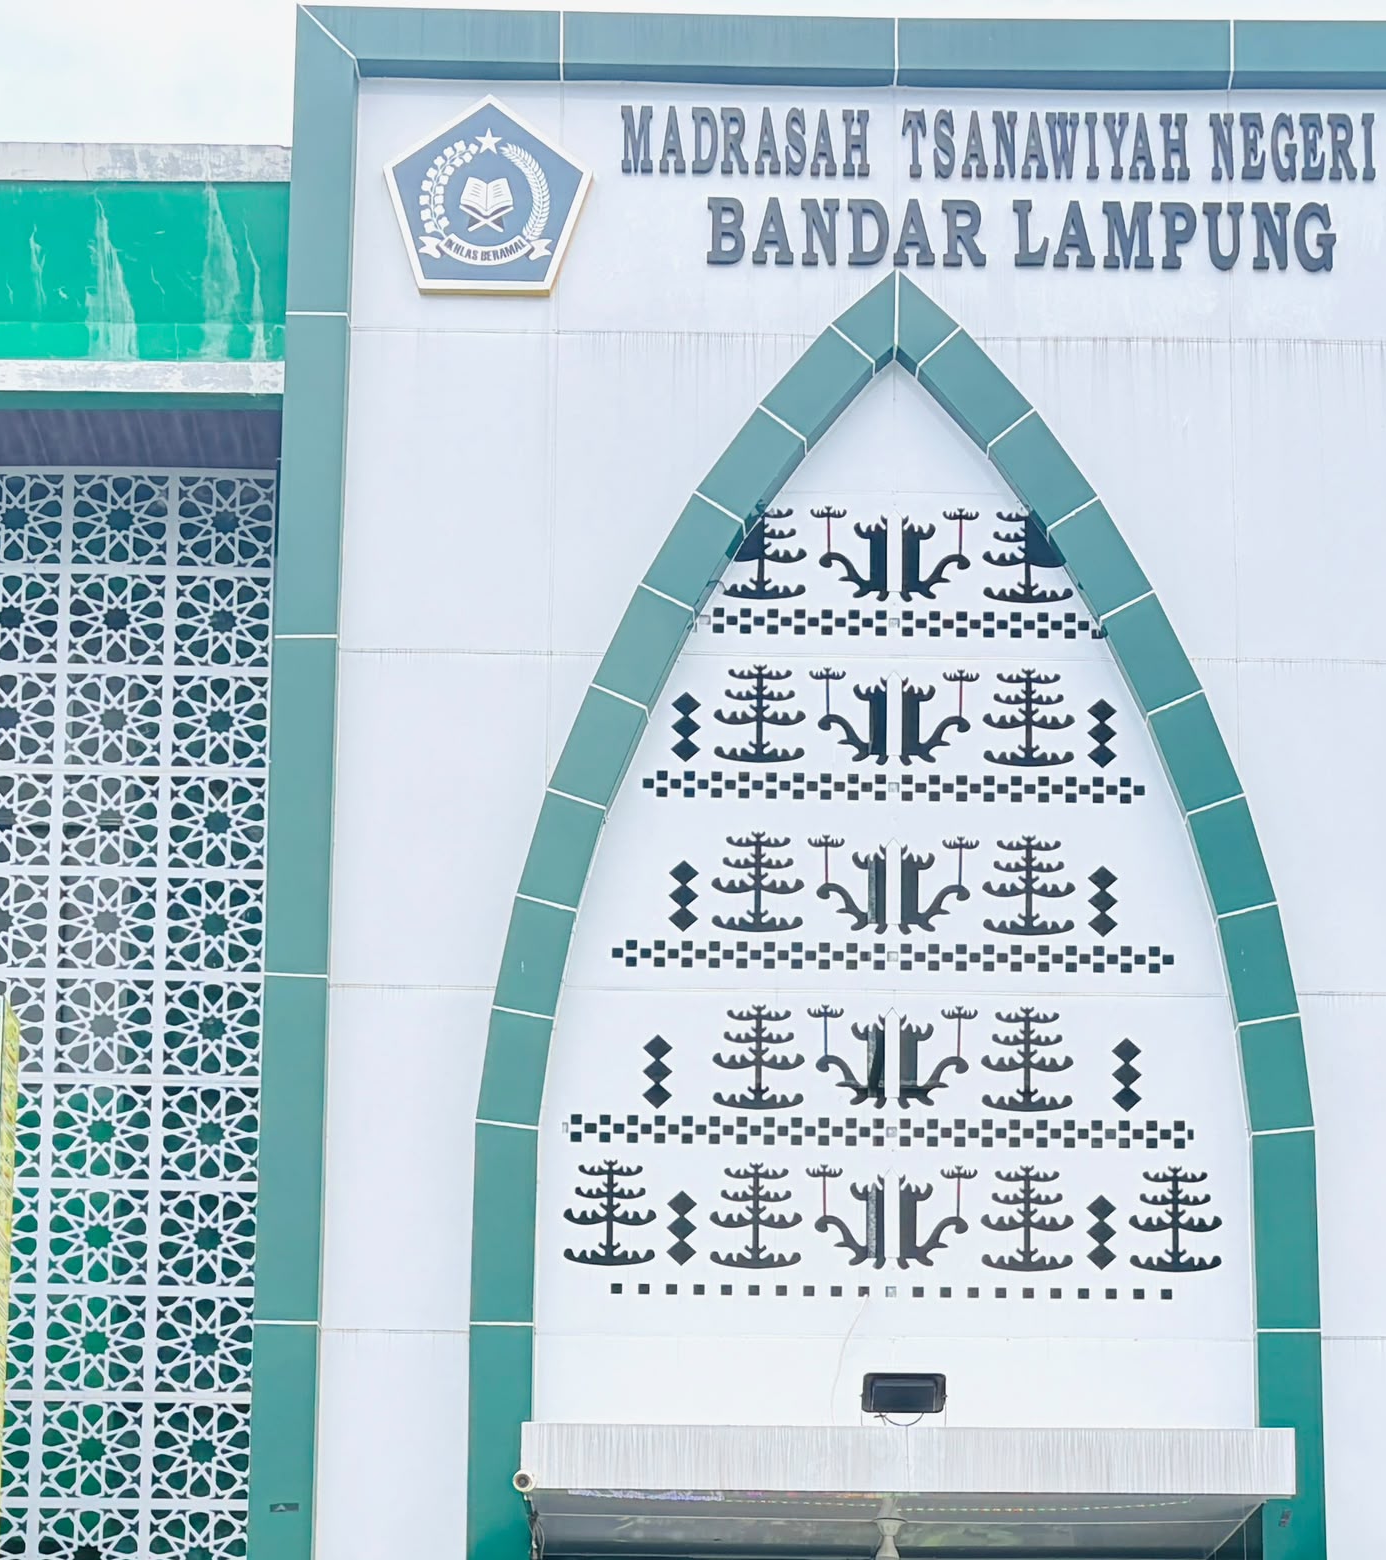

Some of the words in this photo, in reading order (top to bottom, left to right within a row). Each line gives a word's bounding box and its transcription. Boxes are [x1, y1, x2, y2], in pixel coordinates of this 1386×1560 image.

[620, 104, 870, 179] MADRASAH
[901, 107, 1191, 182] TSANAWIYAH
[1208, 111, 1376, 183] NEGERI
[445, 238, 478, 261] IKHLAS
[480, 239, 527, 261] BERAMAL
[706, 196, 987, 274] BANDAR
[1012, 198, 1337, 274] LAMPUNG
